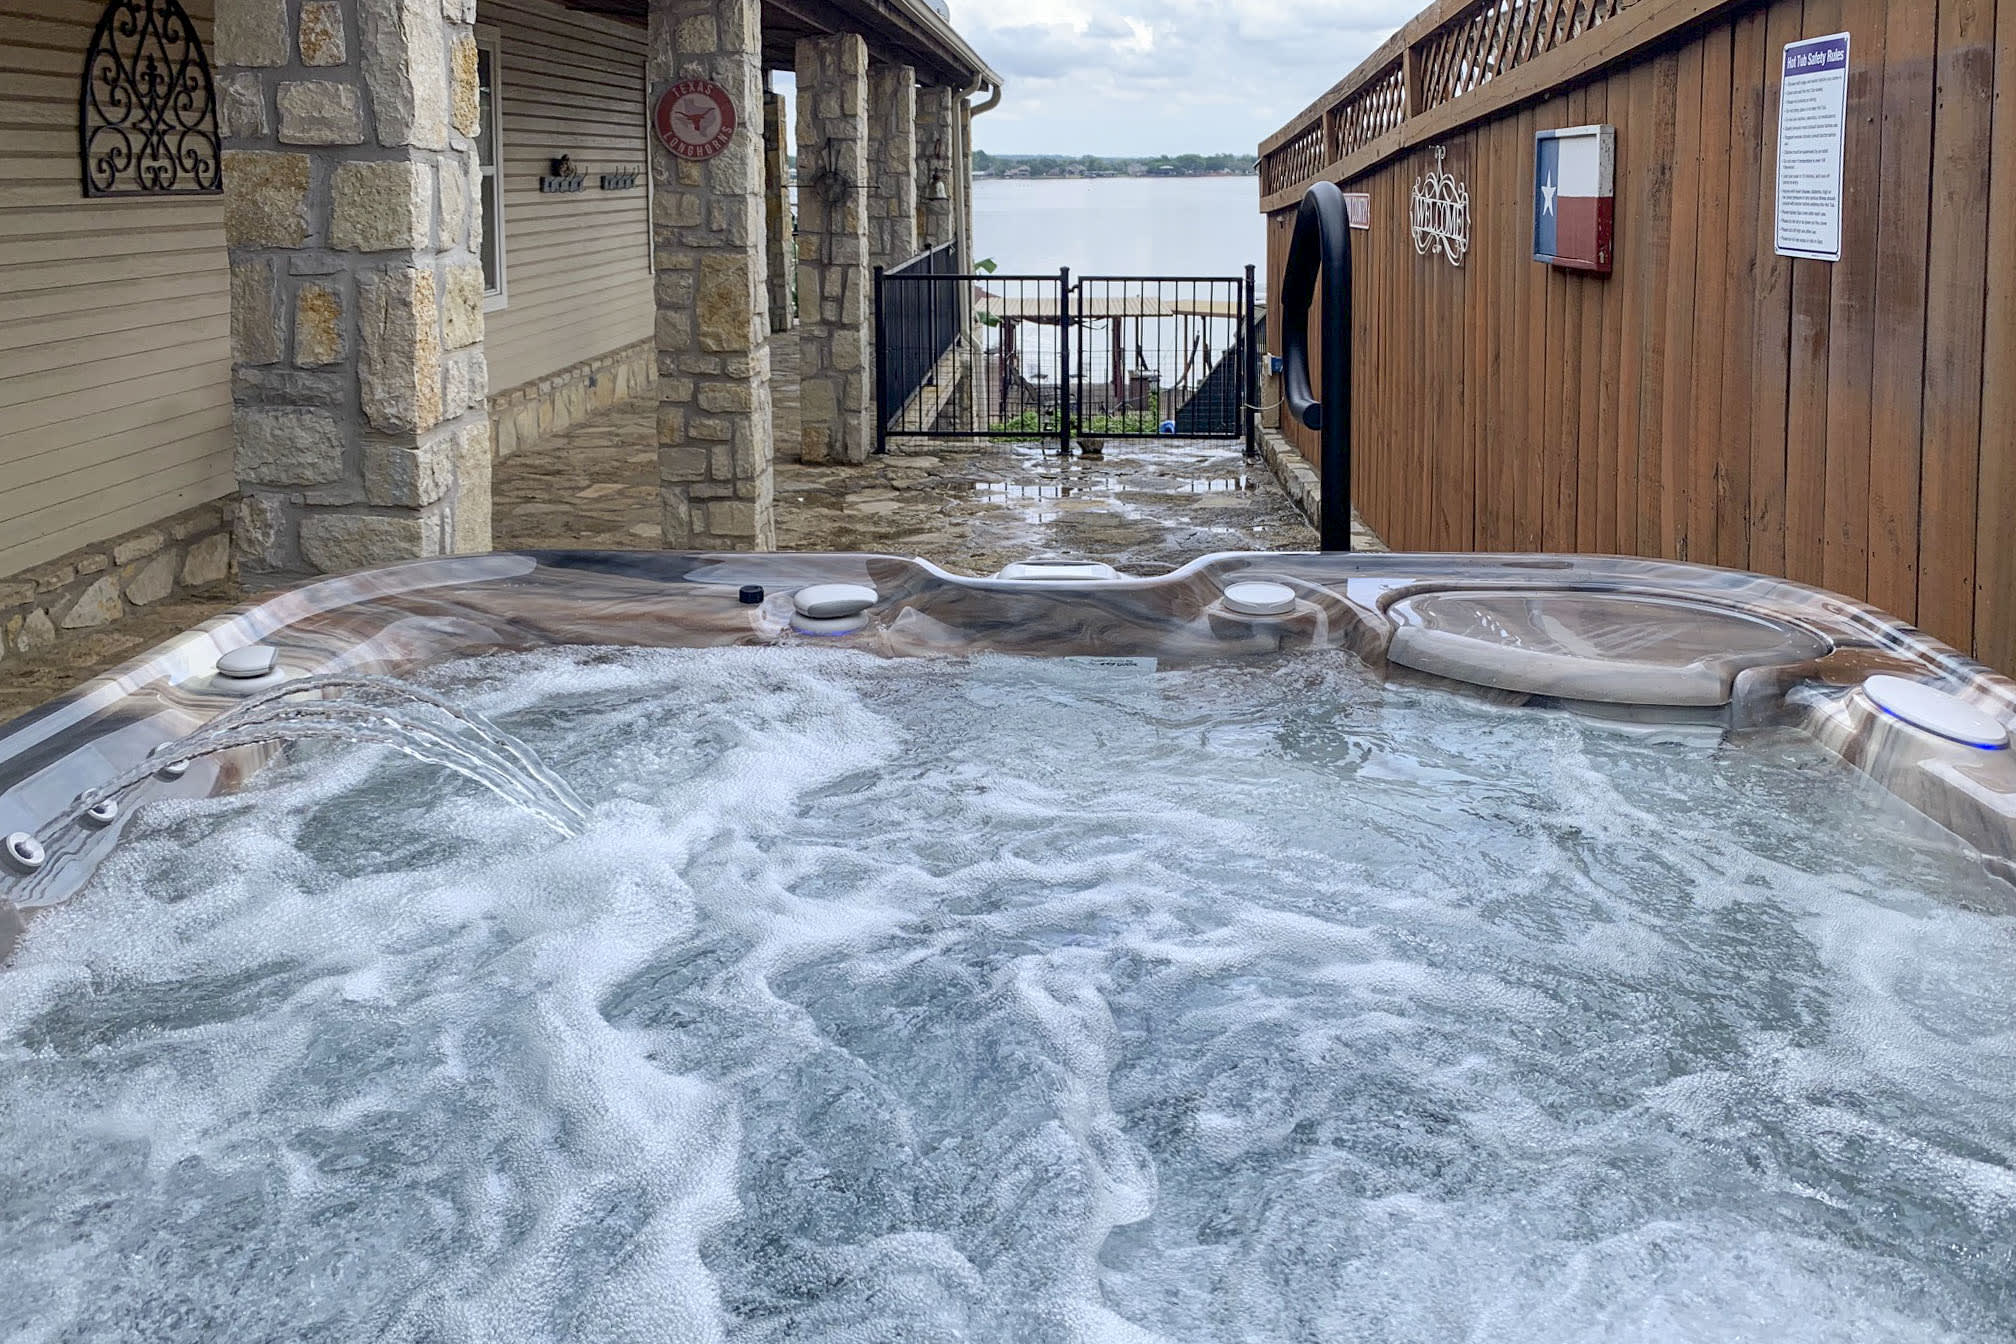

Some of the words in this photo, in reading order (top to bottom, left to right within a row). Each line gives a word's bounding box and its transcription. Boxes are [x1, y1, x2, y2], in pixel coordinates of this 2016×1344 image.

[1787, 56, 1796, 69] Hot
[1797, 55, 1807, 67] Tub
[1808, 51, 1827, 66] Safety
[1827, 48, 1844, 62] Rules
[672, 81, 713, 97] TEXAS
[663, 126, 732, 157] LONGHORNS
[1415, 197, 1464, 240] WELCOME
